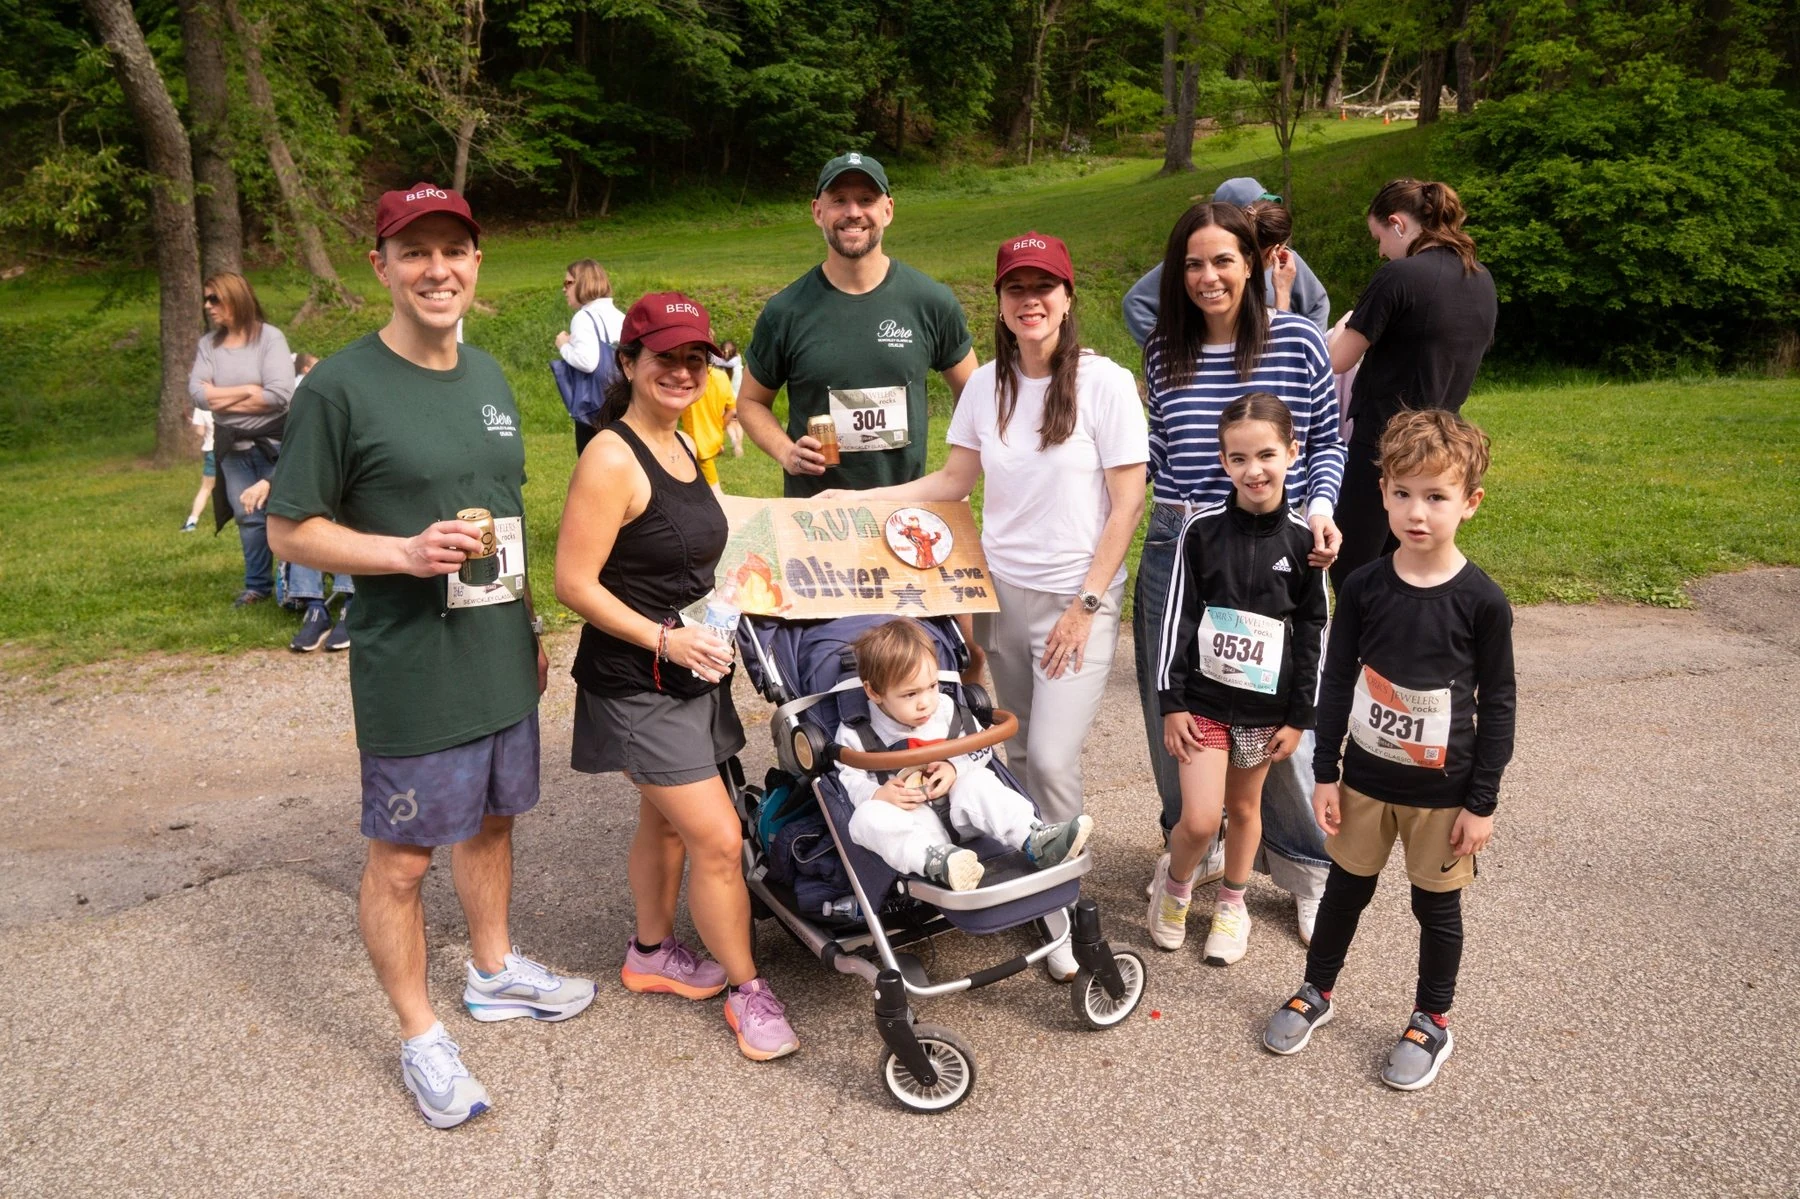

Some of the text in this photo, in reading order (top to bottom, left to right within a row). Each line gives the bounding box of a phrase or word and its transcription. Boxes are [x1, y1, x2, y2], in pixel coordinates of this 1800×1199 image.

[405, 187, 448, 203] BERO
[1013, 238, 1047, 251] BERO
[665, 303, 699, 318] BERO
[877, 319, 912, 338] Bero
[482, 404, 512, 425] Bero
[853, 409, 887, 431] 304
[810, 423, 836, 435] BERO
[501, 532, 516, 541] rocks
[785, 556, 890, 599] Oliver
[938, 566, 984, 582] Love
[1253, 629, 1273, 638] rocks
[1212, 633, 1265, 666] 9534
[1366, 674, 1440, 706] ORR'S JEWELERS
[1412, 705, 1437, 713] rocks
[1368, 702, 1425, 743] 9231
[1383, 752, 1412, 763] CLASSIC
[1288, 997, 1312, 1014] NIKE
[1404, 1027, 1429, 1045] NIKE
